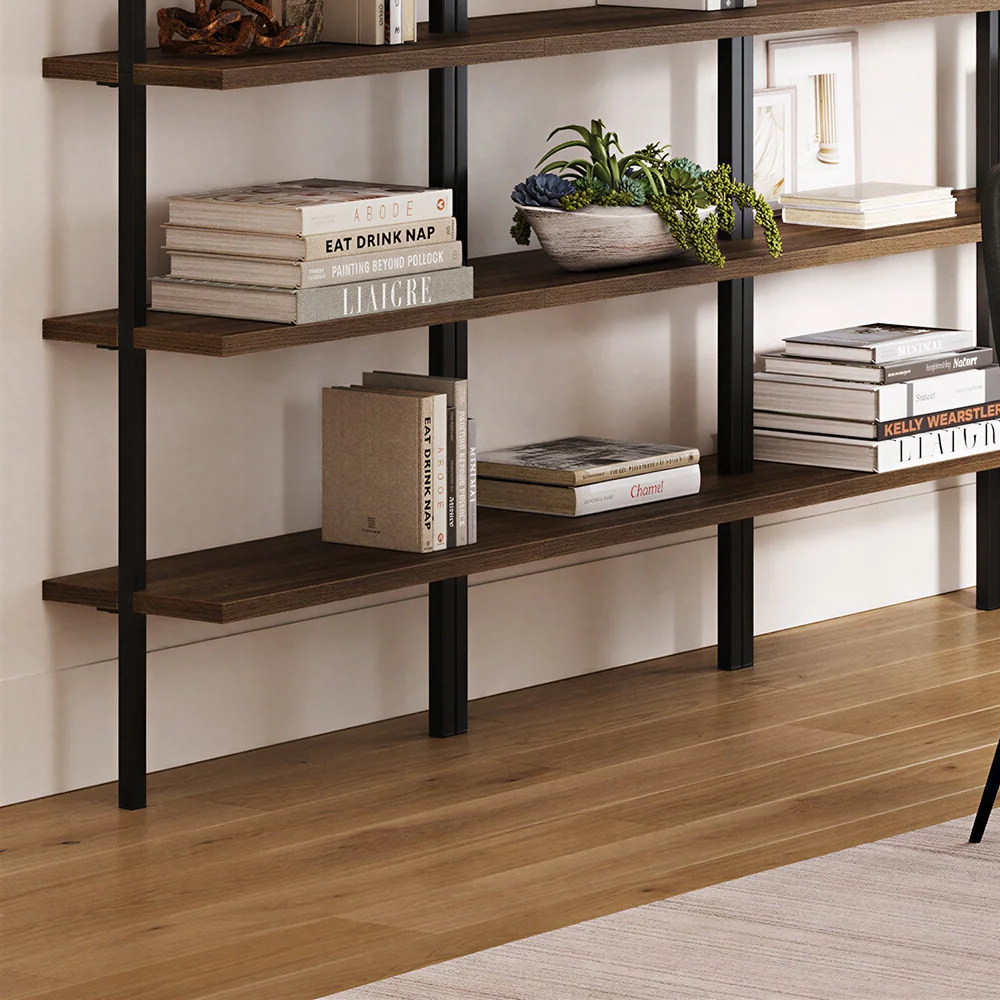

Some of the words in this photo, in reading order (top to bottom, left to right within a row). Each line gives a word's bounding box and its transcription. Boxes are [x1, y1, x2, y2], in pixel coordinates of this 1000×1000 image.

[353, 200, 415, 223] ABODE
[325, 237, 352, 253] EAT
[357, 230, 402, 249] DRINK
[405, 226, 436, 242] NAP
[332, 261, 370, 278] PAINTING
[372, 257, 405, 272] BEYOND
[407, 251, 444, 267] POLLOCK
[423, 416, 432, 444] EAT
[884, 417, 924, 437] KELLY
[423, 448, 432, 497] DRINK
[424, 500, 433, 530] NAP
